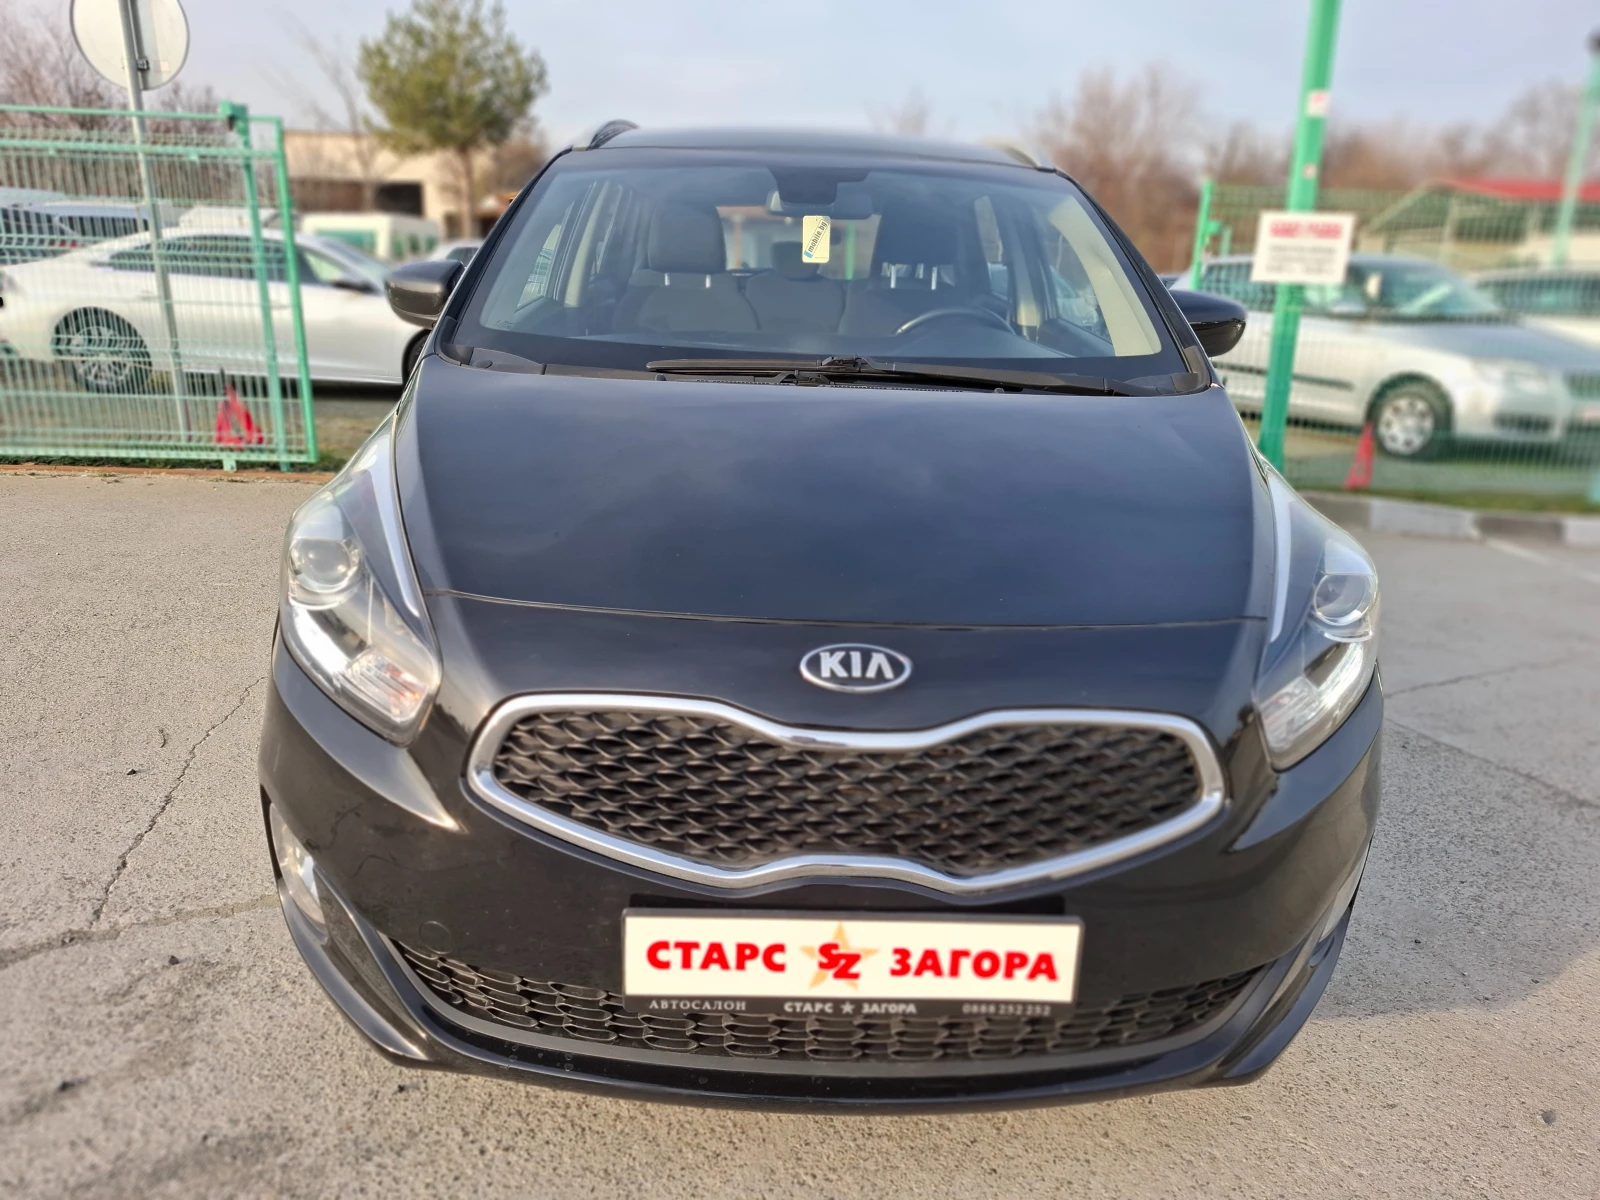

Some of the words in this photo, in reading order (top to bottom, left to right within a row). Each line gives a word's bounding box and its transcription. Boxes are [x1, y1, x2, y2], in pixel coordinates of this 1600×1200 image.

[808, 221, 828, 253] mobile.bg
[820, 651, 895, 679] KIA
[646, 940, 787, 973] СТАРС
[817, 942, 861, 980] SZ
[889, 948, 1059, 982] ЗАГОРА
[649, 1000, 747, 1011] АВТОСАЛОН
[783, 1001, 834, 1014] СТАРС
[861, 1003, 917, 1015] ЗАГОРА
